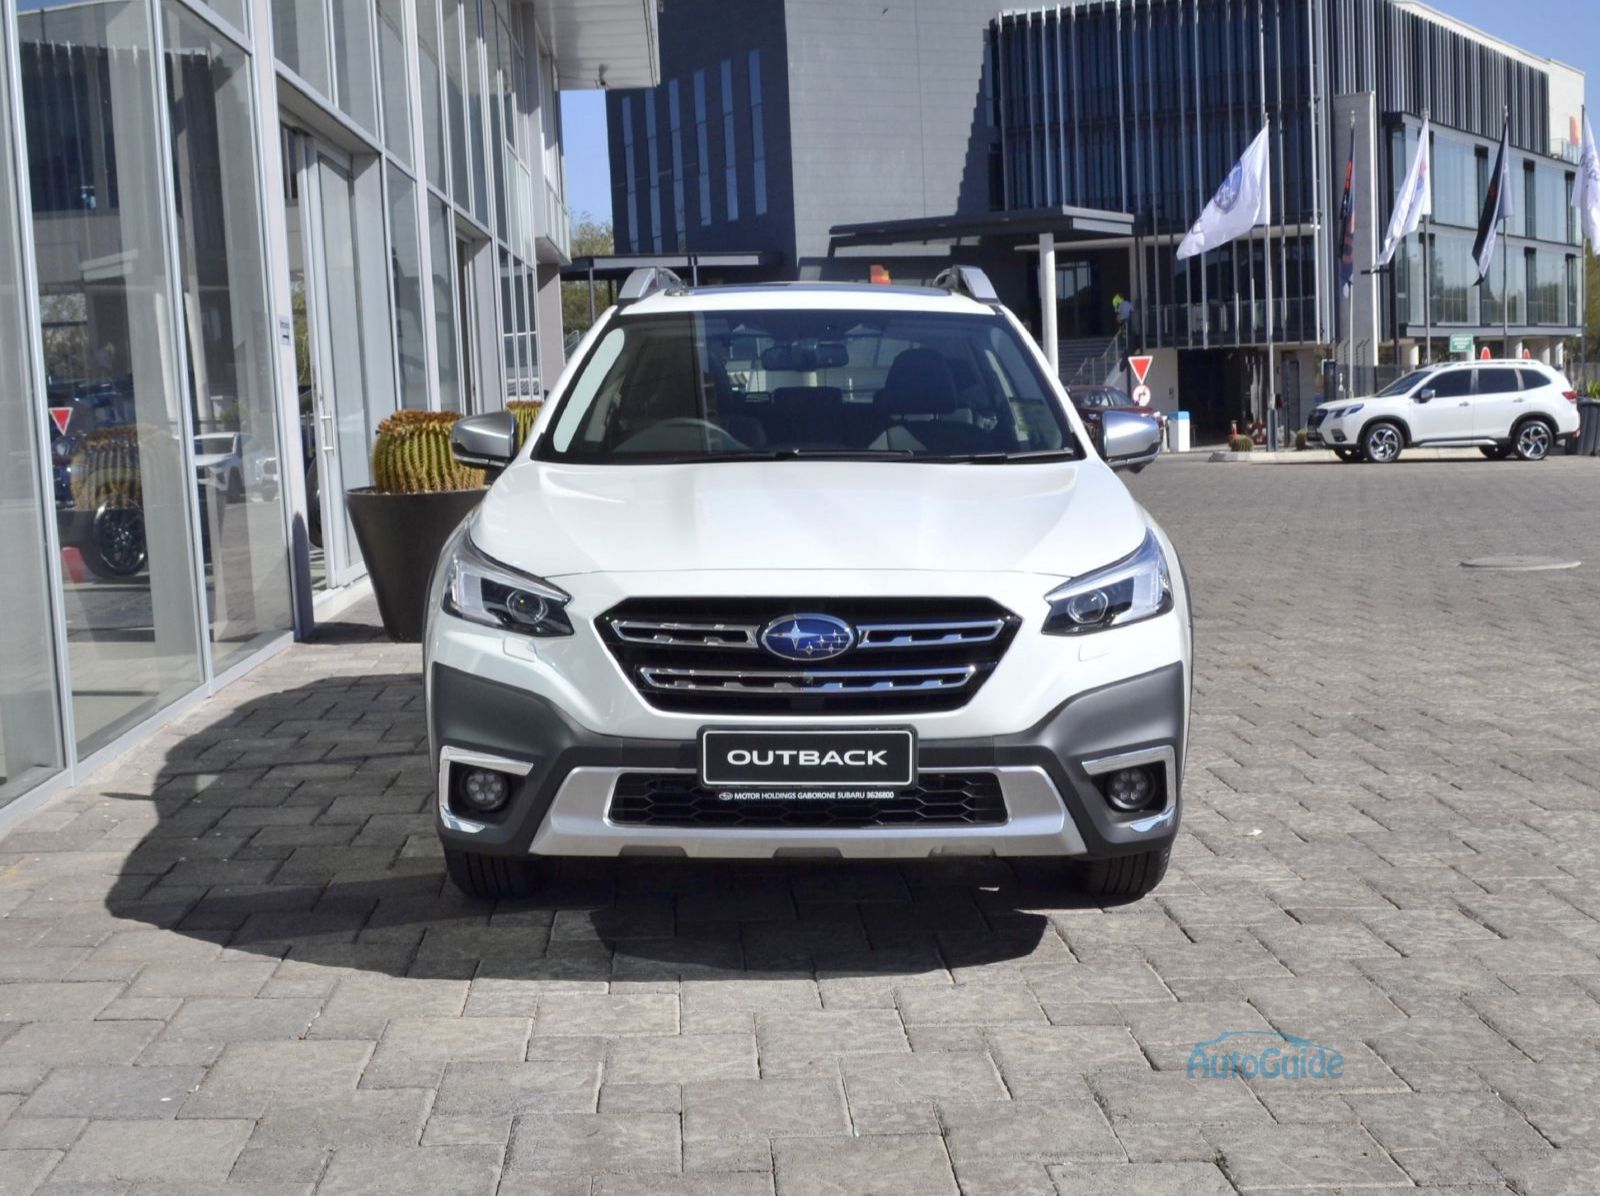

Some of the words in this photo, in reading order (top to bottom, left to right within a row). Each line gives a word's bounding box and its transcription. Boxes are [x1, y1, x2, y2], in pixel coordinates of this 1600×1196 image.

[727, 750, 888, 766] OUTBACK
[734, 791, 761, 800] MOTOR
[761, 791, 797, 800] HOLDINGS
[797, 791, 837, 800] GABORONE
[837, 791, 865, 799] SUBARU
